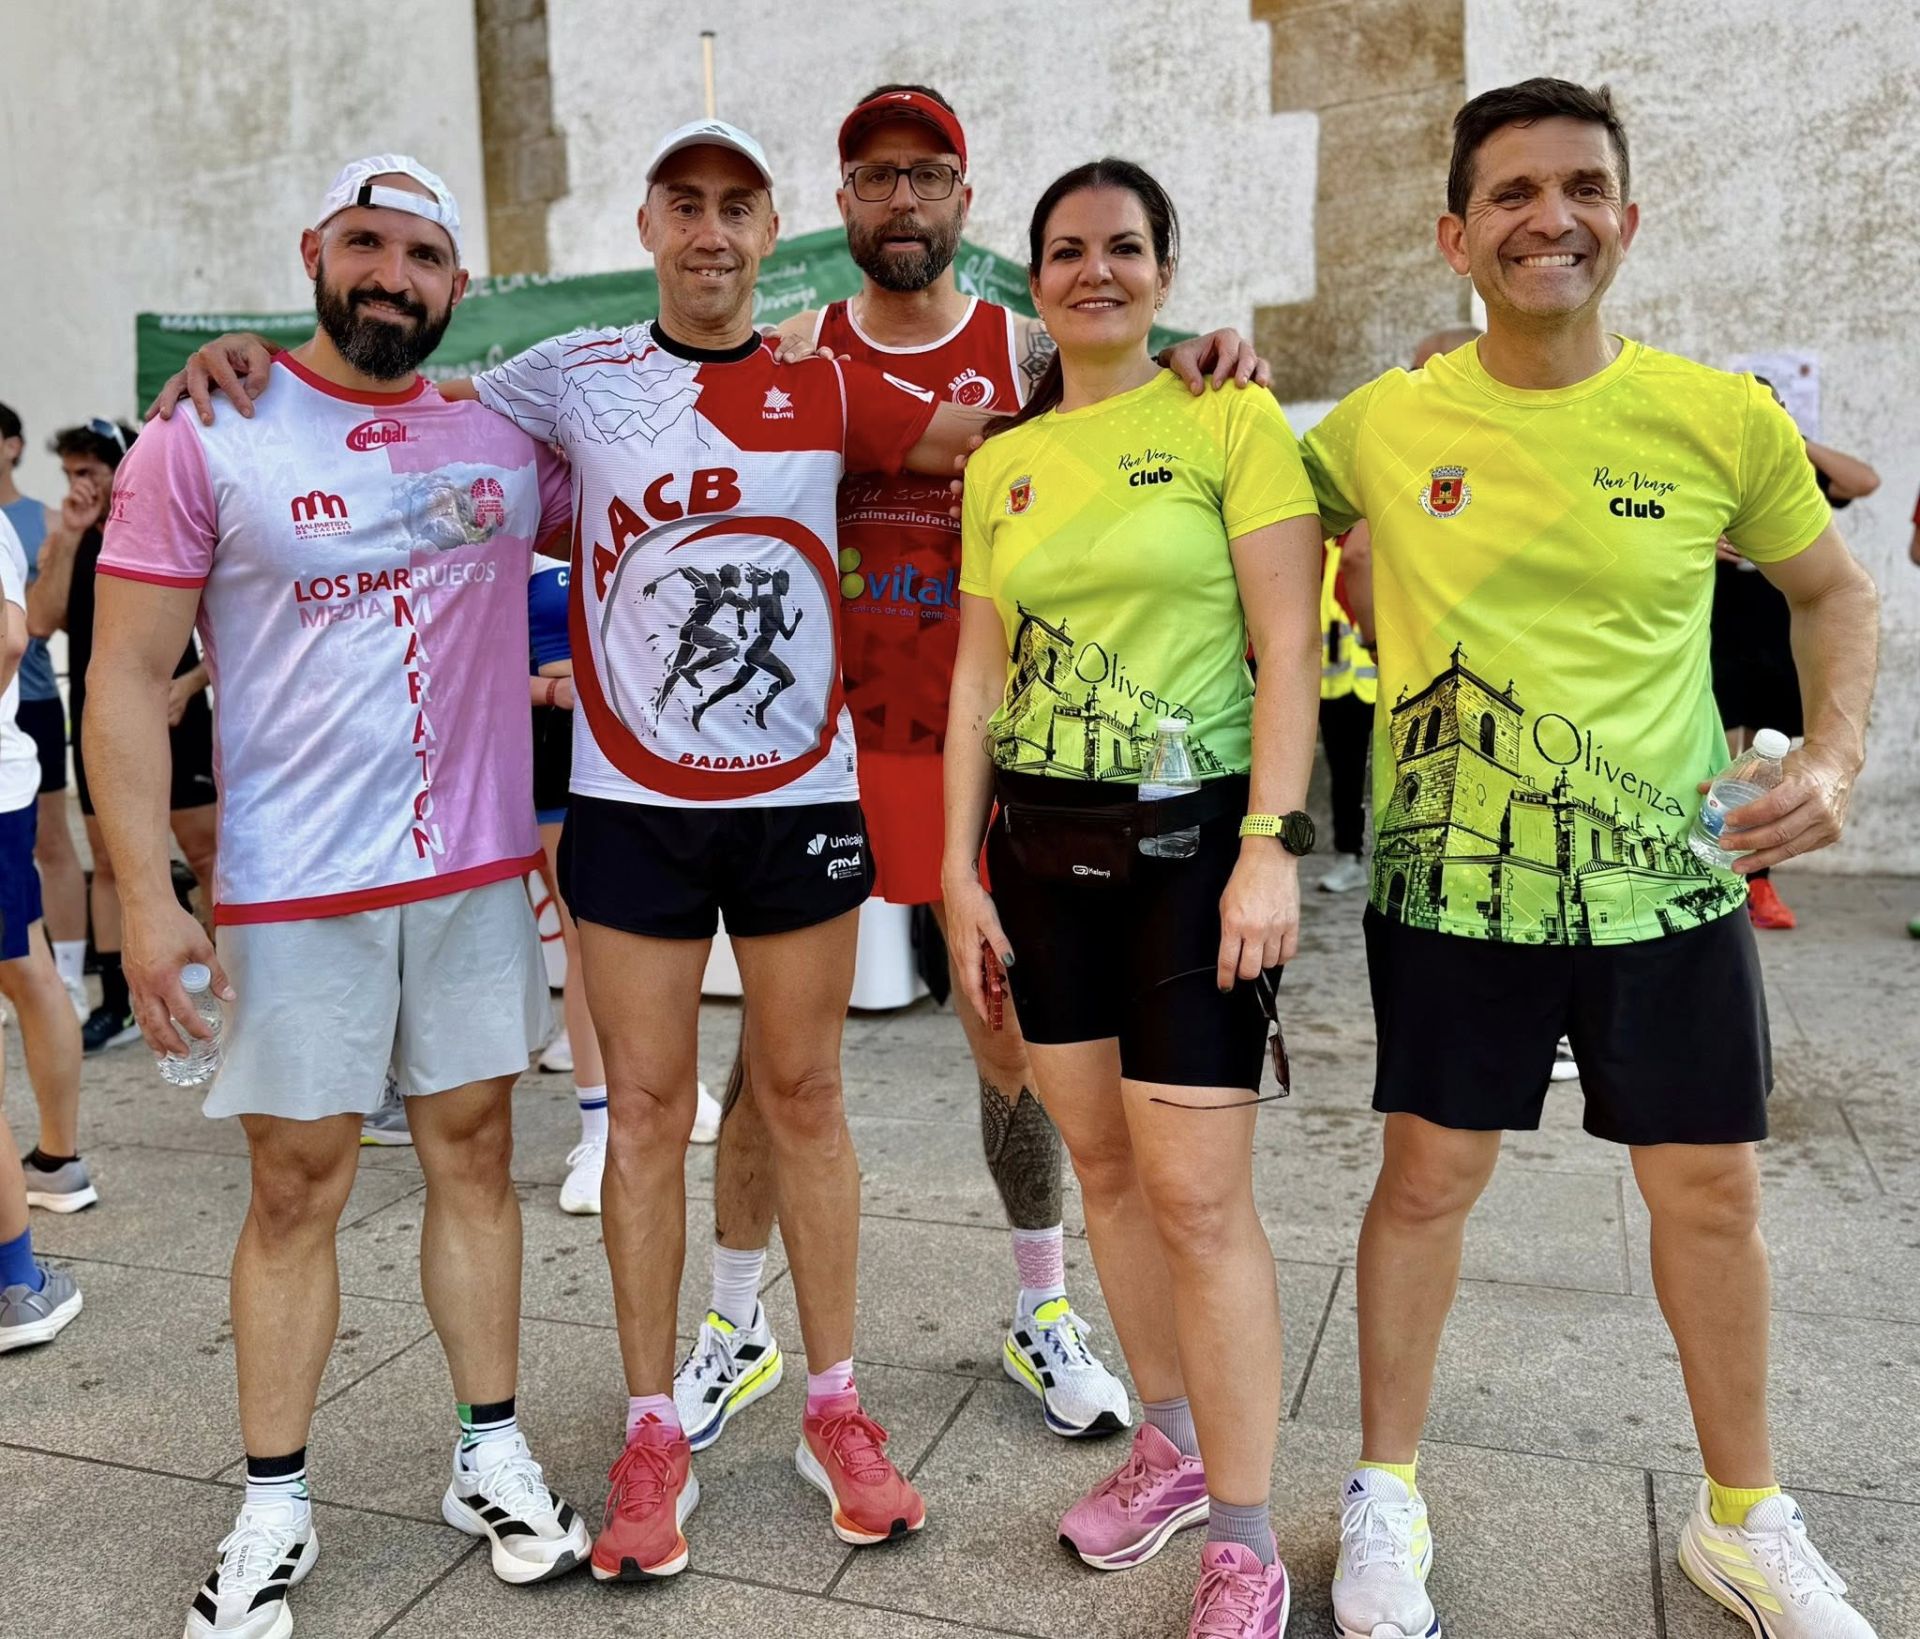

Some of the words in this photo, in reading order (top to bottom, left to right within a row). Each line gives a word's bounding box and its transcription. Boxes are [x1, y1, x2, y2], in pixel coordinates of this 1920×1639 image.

[947, 368, 976, 391] aacb
[762, 410, 794, 420] luanvi
[355, 425, 407, 448] global
[1118, 453, 1143, 470] Run
[1129, 466, 1173, 487] Club
[1593, 466, 1629, 491] Run
[1629, 471, 1680, 496] Venza
[1609, 497, 1665, 519] Club
[592, 467, 742, 603] AACB
[294, 574, 350, 602] LOS
[357, 561, 496, 595] BARRUECOS
[299, 597, 387, 629] MEDIA
[1074, 642, 1194, 725] Olivenza
[678, 749, 782, 769] BADAJOZ
[1533, 713, 1686, 818] Olivenza
